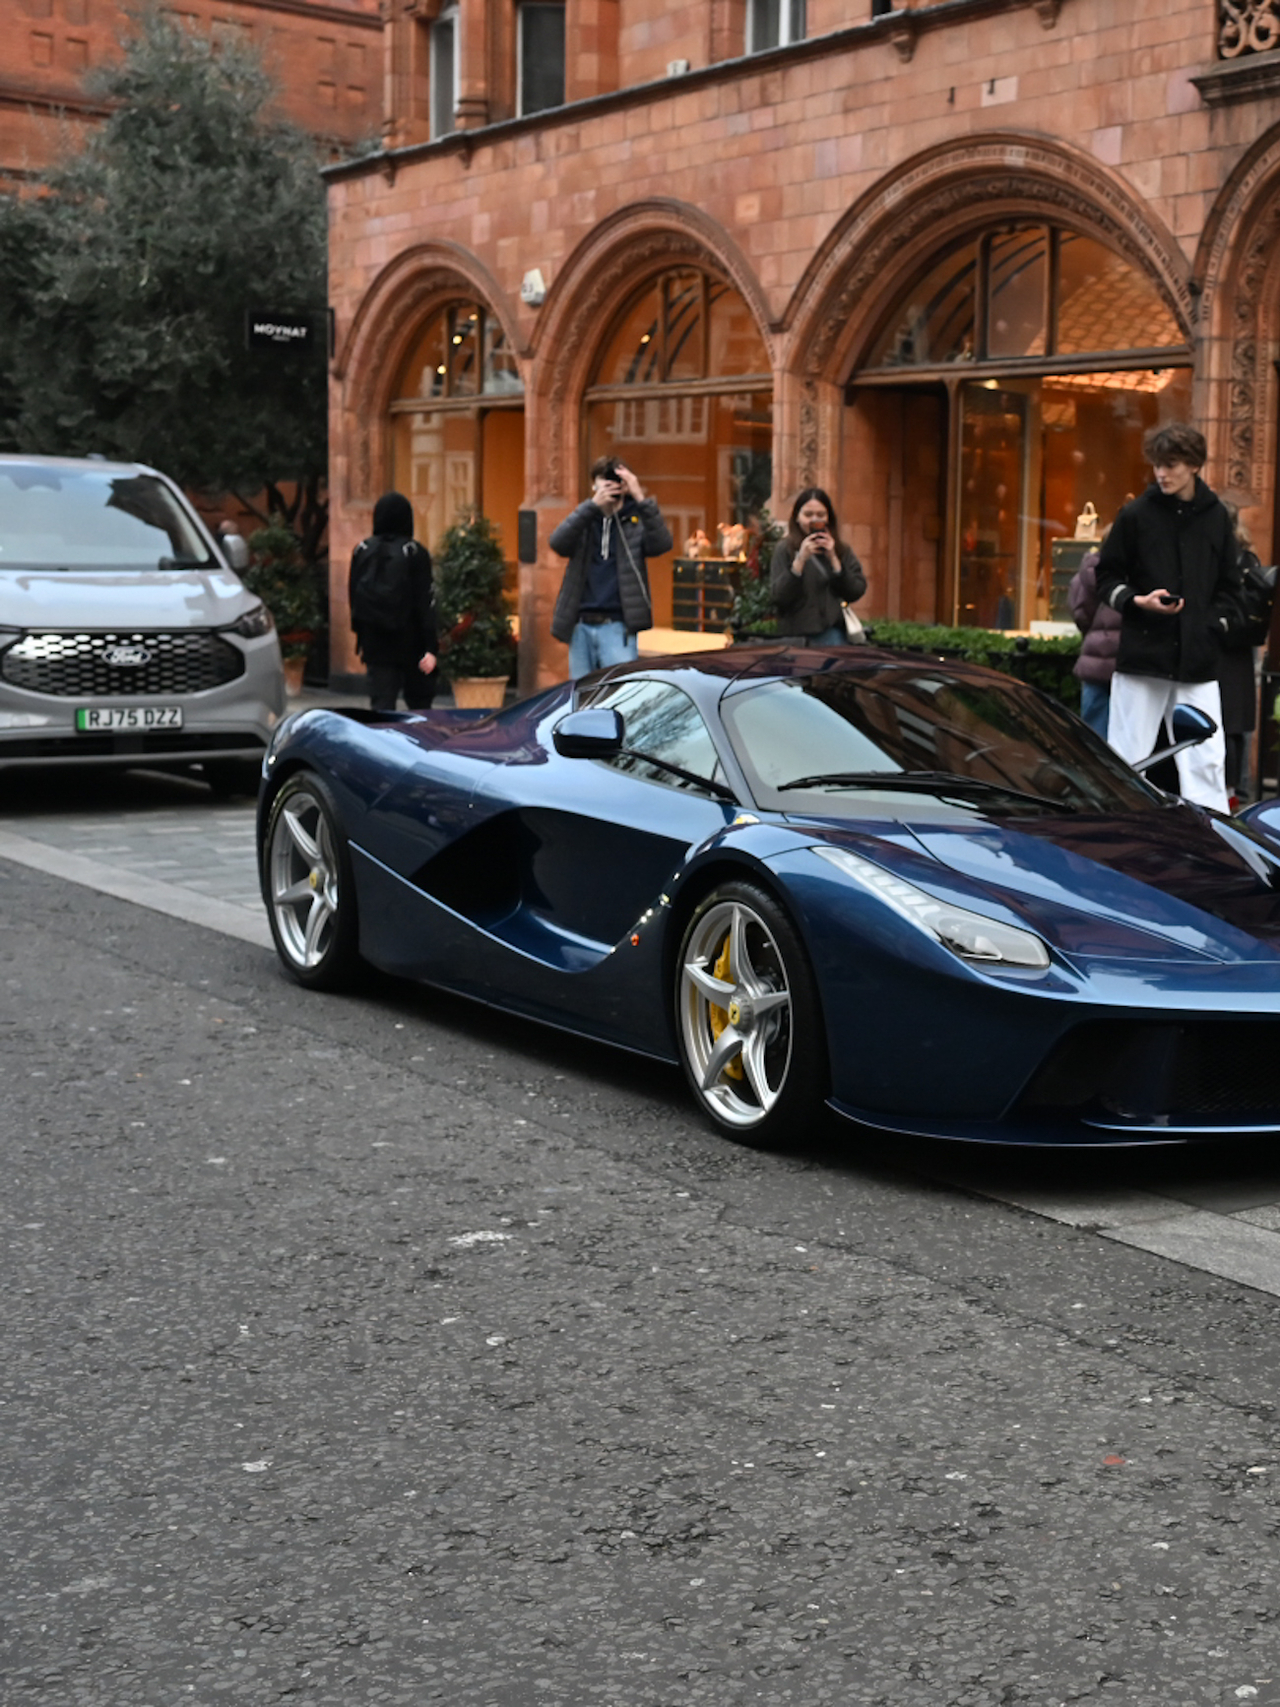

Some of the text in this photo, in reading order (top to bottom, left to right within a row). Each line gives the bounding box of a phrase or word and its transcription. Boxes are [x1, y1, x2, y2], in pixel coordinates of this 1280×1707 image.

[253, 323, 307, 338] MOYNAT
[88, 708, 179, 727] RJ75 DZZ
